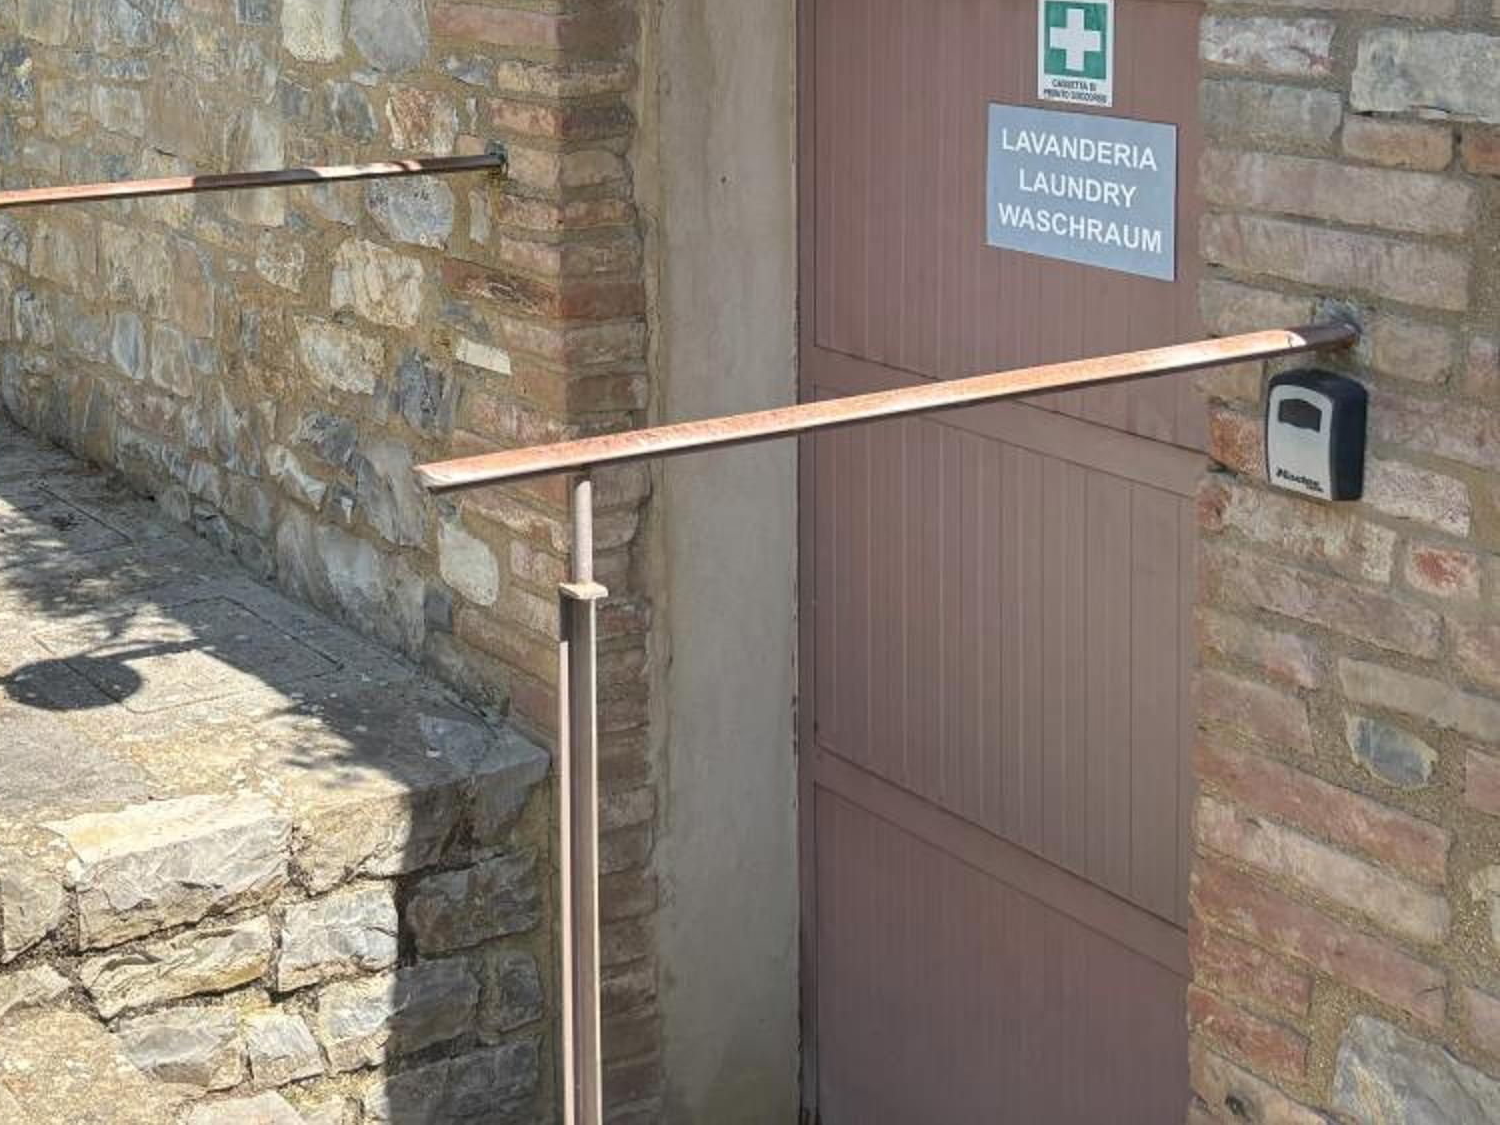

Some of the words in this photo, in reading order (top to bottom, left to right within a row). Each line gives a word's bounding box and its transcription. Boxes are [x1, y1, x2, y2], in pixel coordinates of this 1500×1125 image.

[1002, 128, 1157, 171] LAVANDERIA
[1019, 168, 1136, 208] LAUNDRY
[998, 202, 1162, 254] WASCHRAUM
